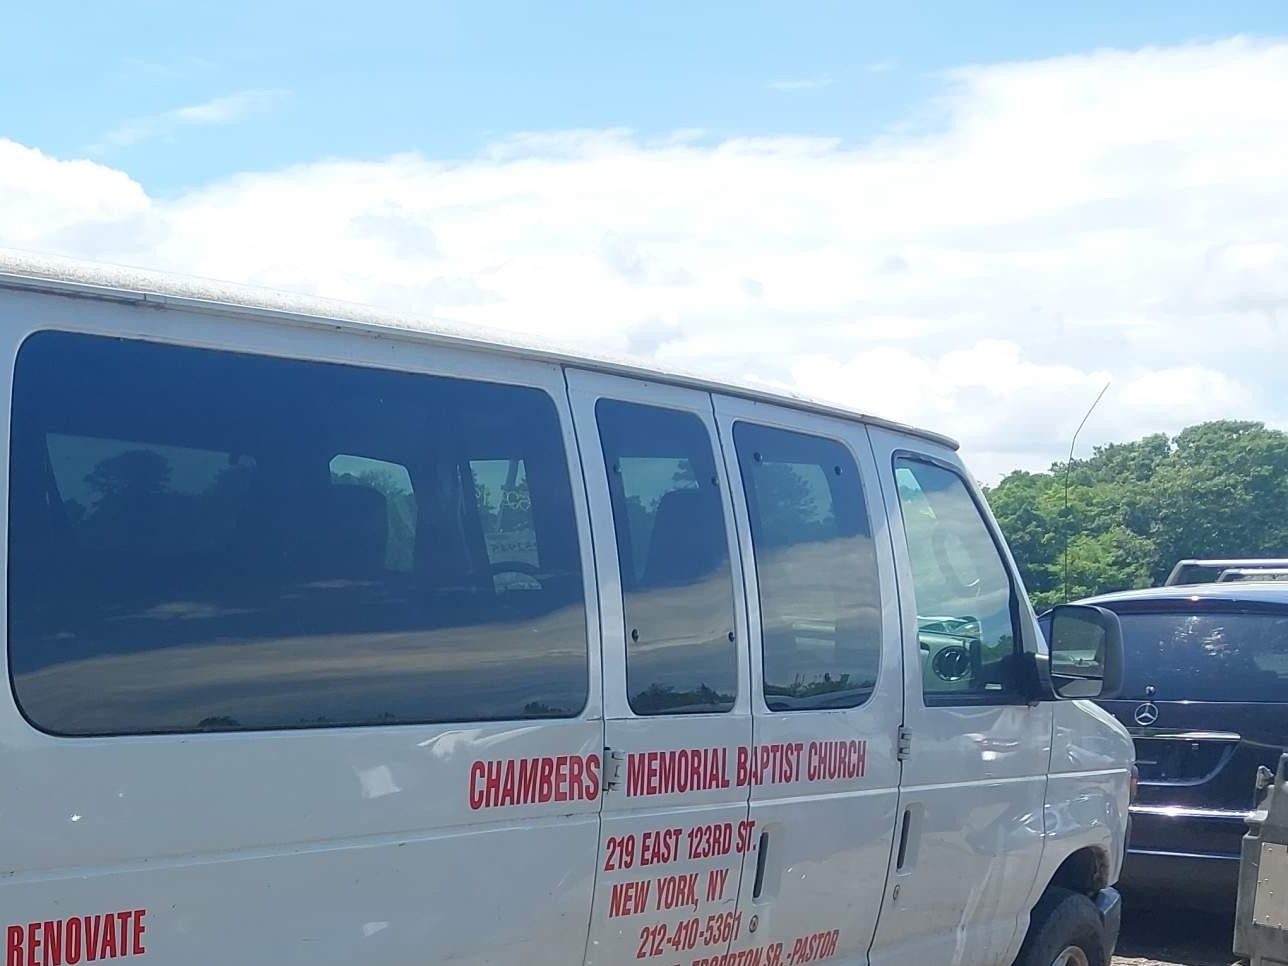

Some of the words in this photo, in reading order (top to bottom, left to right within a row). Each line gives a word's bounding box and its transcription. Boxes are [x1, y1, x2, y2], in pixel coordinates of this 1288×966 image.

[470, 754, 600, 809] CHAMBERS
[626, 750, 730, 797] MEMORIAL
[737, 743, 803, 786] BAPTIST
[807, 740, 866, 781] CHURCH
[604, 837, 635, 871] 219
[641, 829, 682, 865] EAST
[687, 823, 732, 859] 123RD
[736, 820, 756, 853] ST.
[609, 881, 651, 918] NEW
[657, 873, 699, 911] YORK,
[706, 868, 729, 902] NY
[637, 912, 742, 959] 212-410-5361
